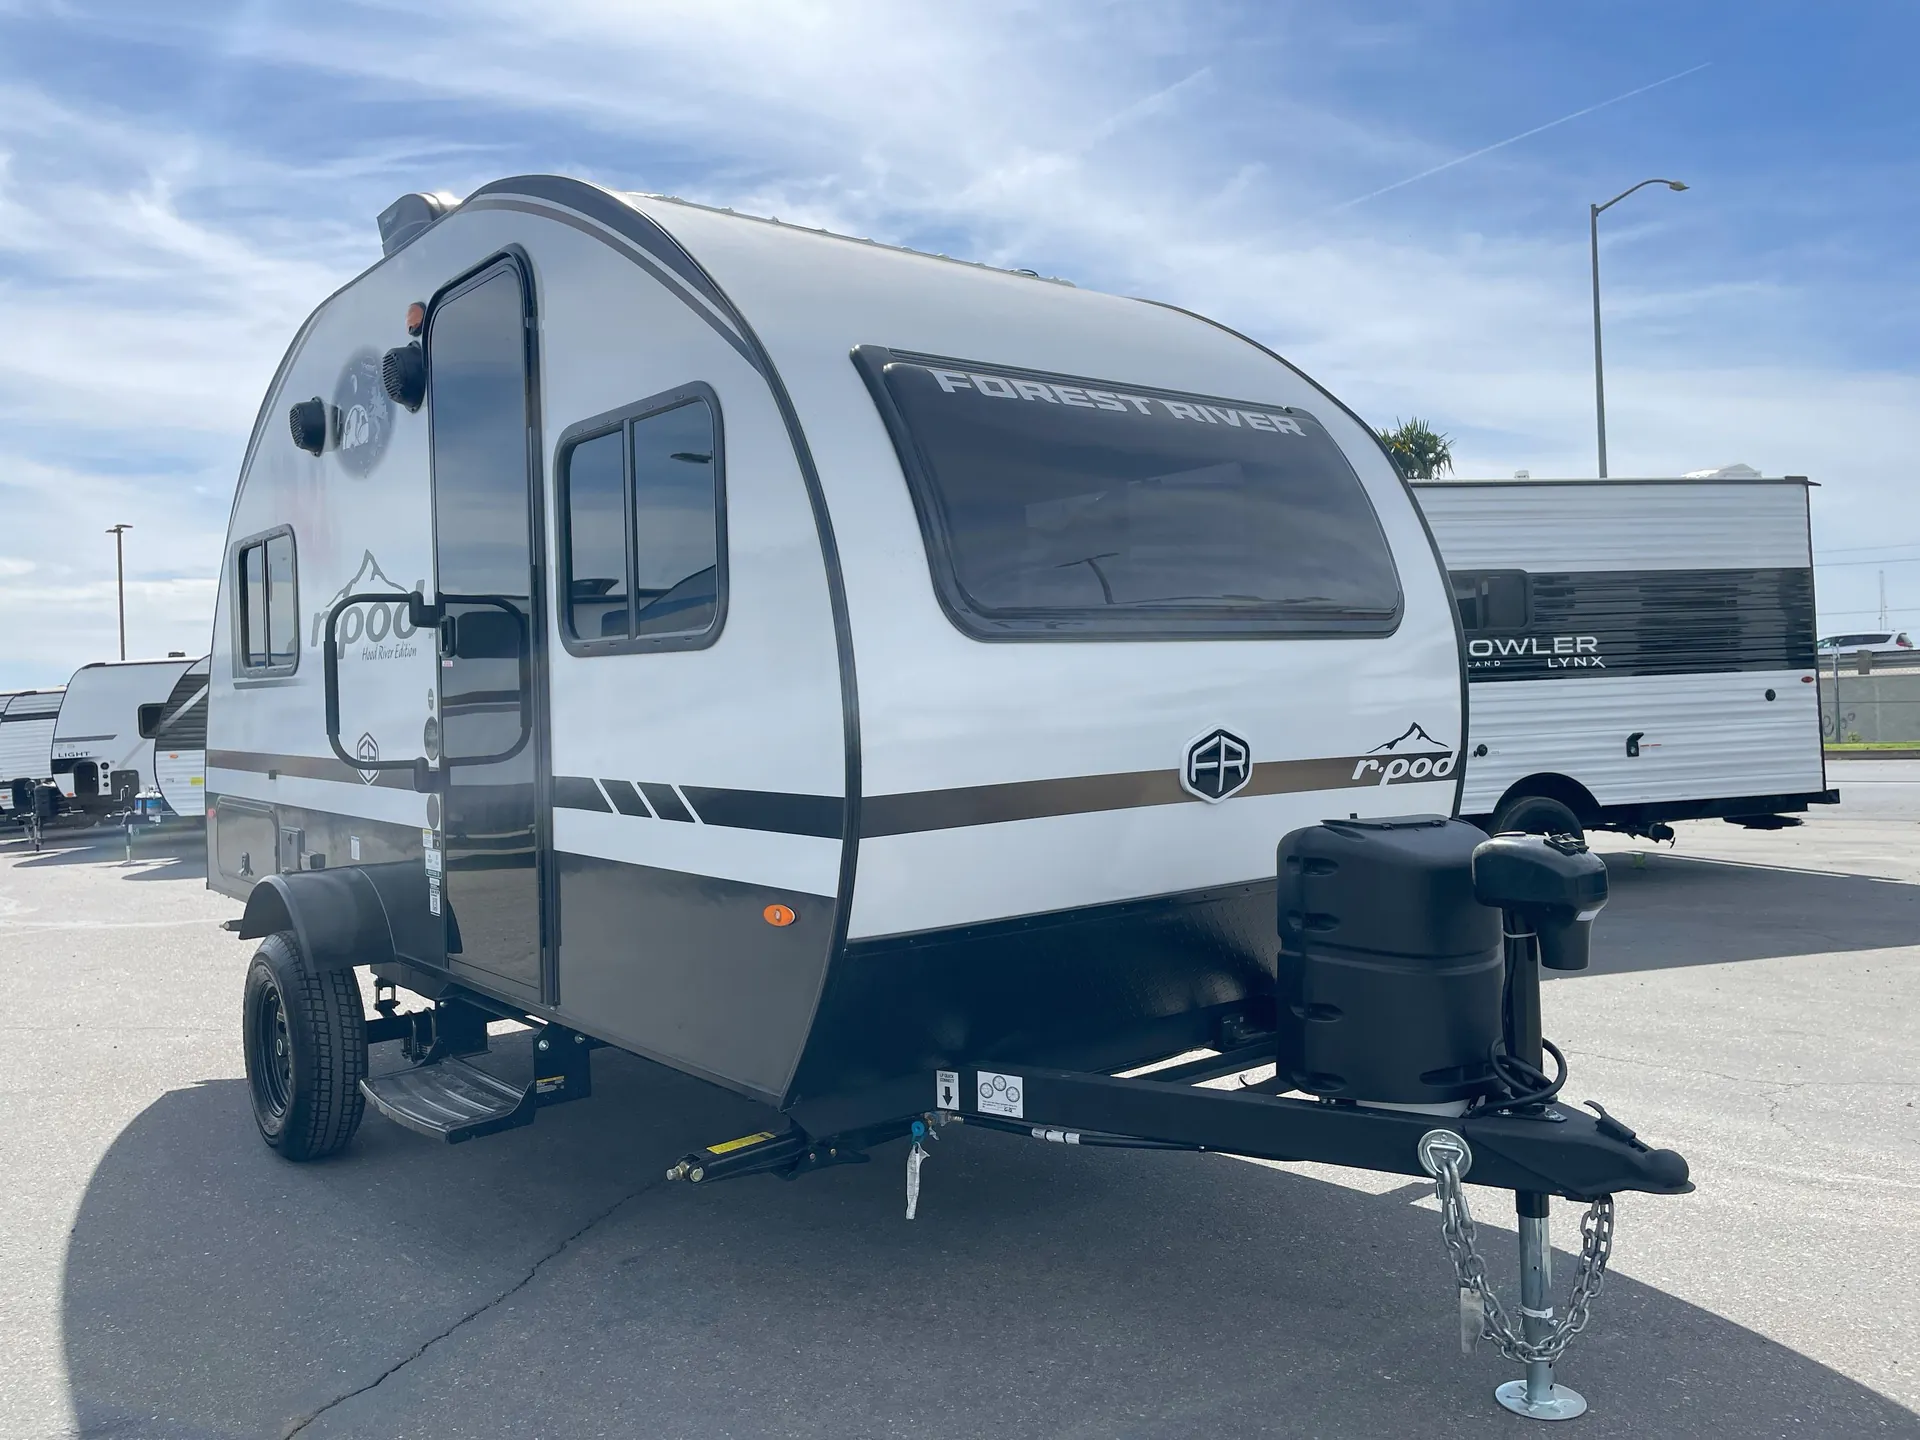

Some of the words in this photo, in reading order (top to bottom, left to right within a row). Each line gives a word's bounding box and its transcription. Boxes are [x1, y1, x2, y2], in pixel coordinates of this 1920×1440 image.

[926, 368, 1152, 415] FOREST
[1158, 400, 1307, 437] RIVER
[362, 644, 377, 660] Hood
[379, 645, 394, 660] River
[394, 642, 417, 659] Edition
[1547, 656, 1606, 668] LYNX
